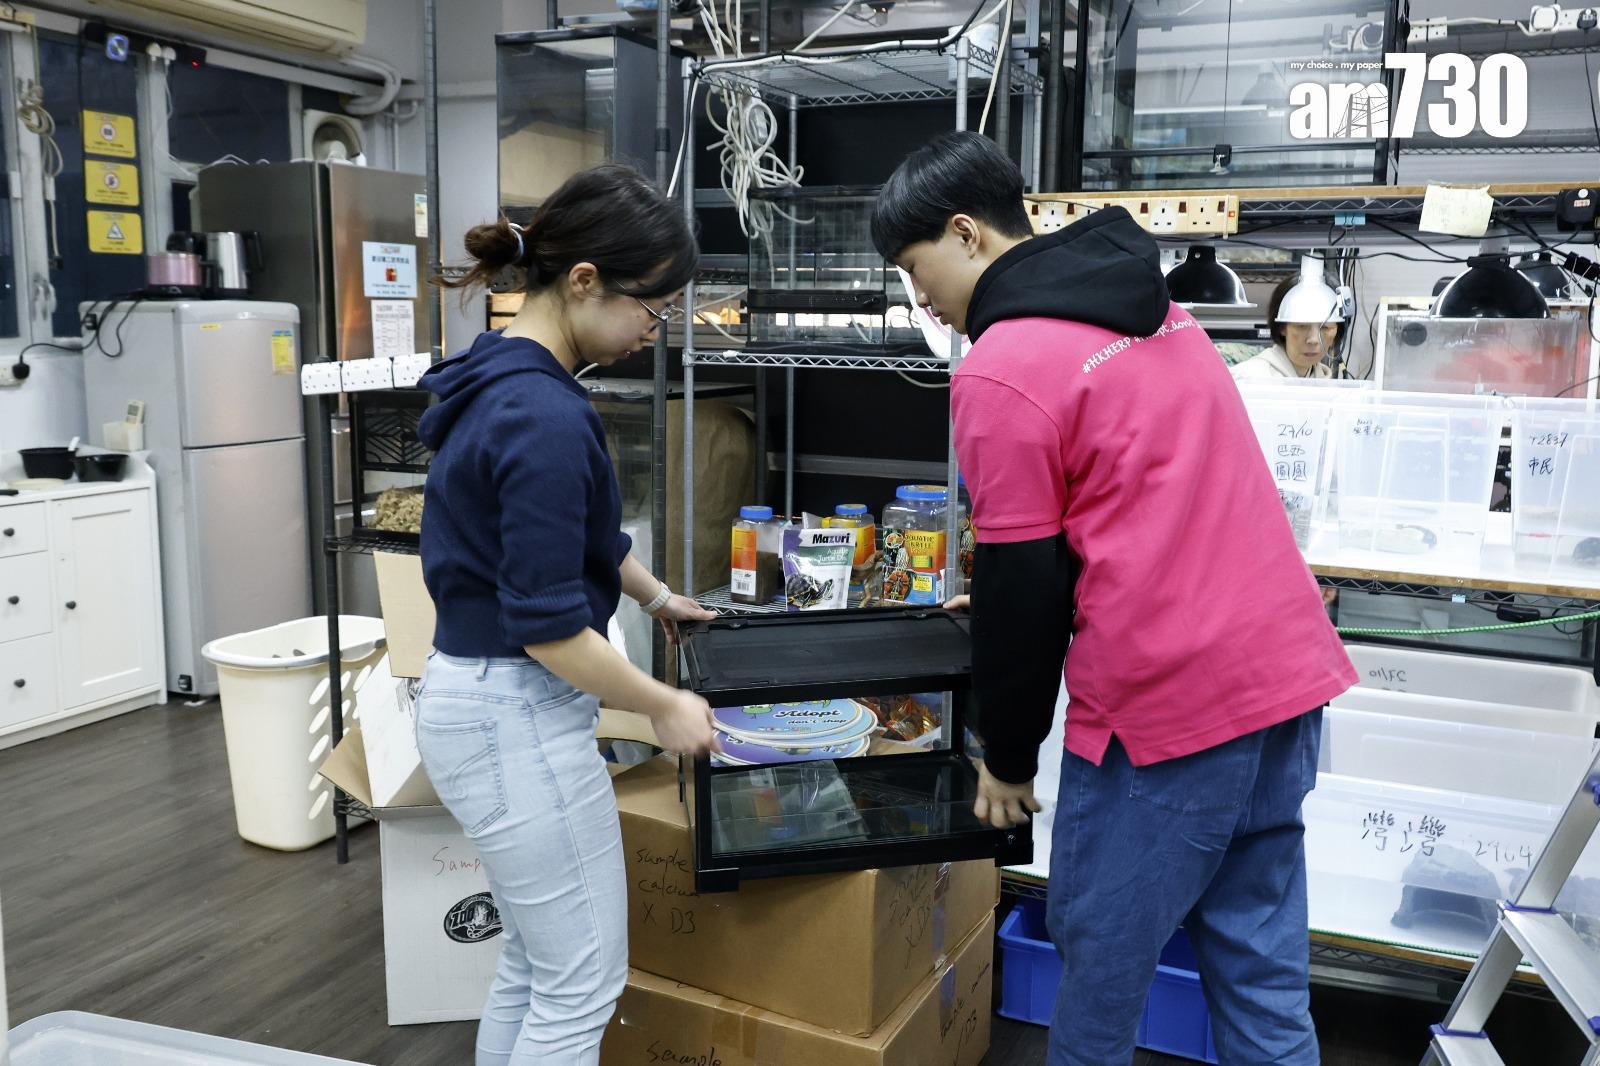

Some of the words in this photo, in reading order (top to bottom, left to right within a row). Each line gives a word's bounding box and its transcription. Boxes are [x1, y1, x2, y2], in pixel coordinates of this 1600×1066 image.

[1082, 336, 1131, 374] #HKHERP
[1277, 419, 1313, 439] 27/10
[812, 532, 851, 545] Mazuri
[775, 709, 841, 718] Adopt
[432, 846, 480, 877] Samp
[671, 907, 696, 934] D3
